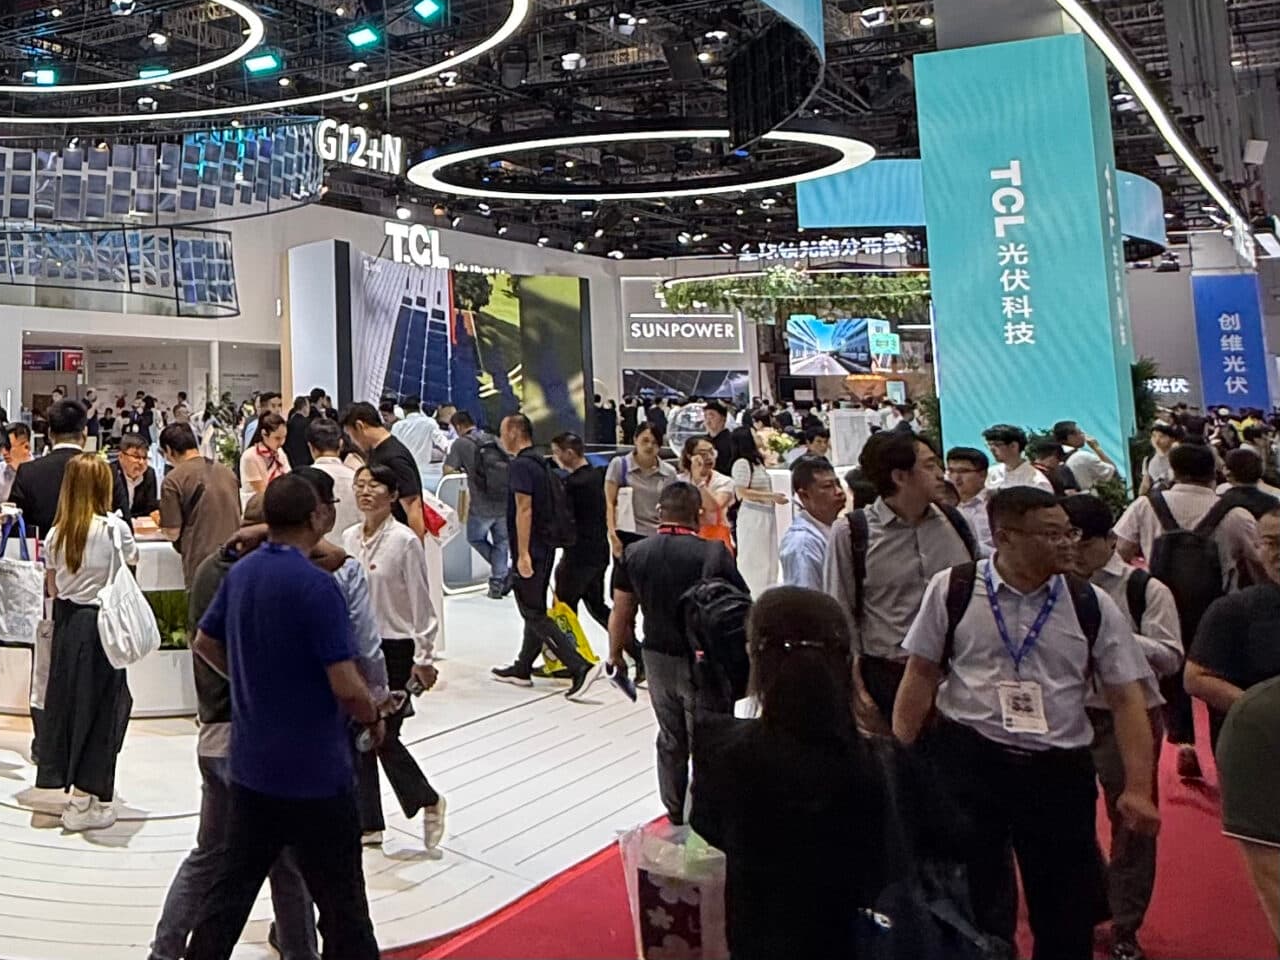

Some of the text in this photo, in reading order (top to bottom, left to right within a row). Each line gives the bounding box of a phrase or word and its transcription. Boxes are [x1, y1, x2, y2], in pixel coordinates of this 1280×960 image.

[317, 118, 403, 175] G12+N
[384, 221, 450, 270] TCL
[989, 159, 1036, 345] TCL 光伏科技
[630, 322, 735, 339] SUNPOWER
[1217, 313, 1249, 395] 创维光伏
